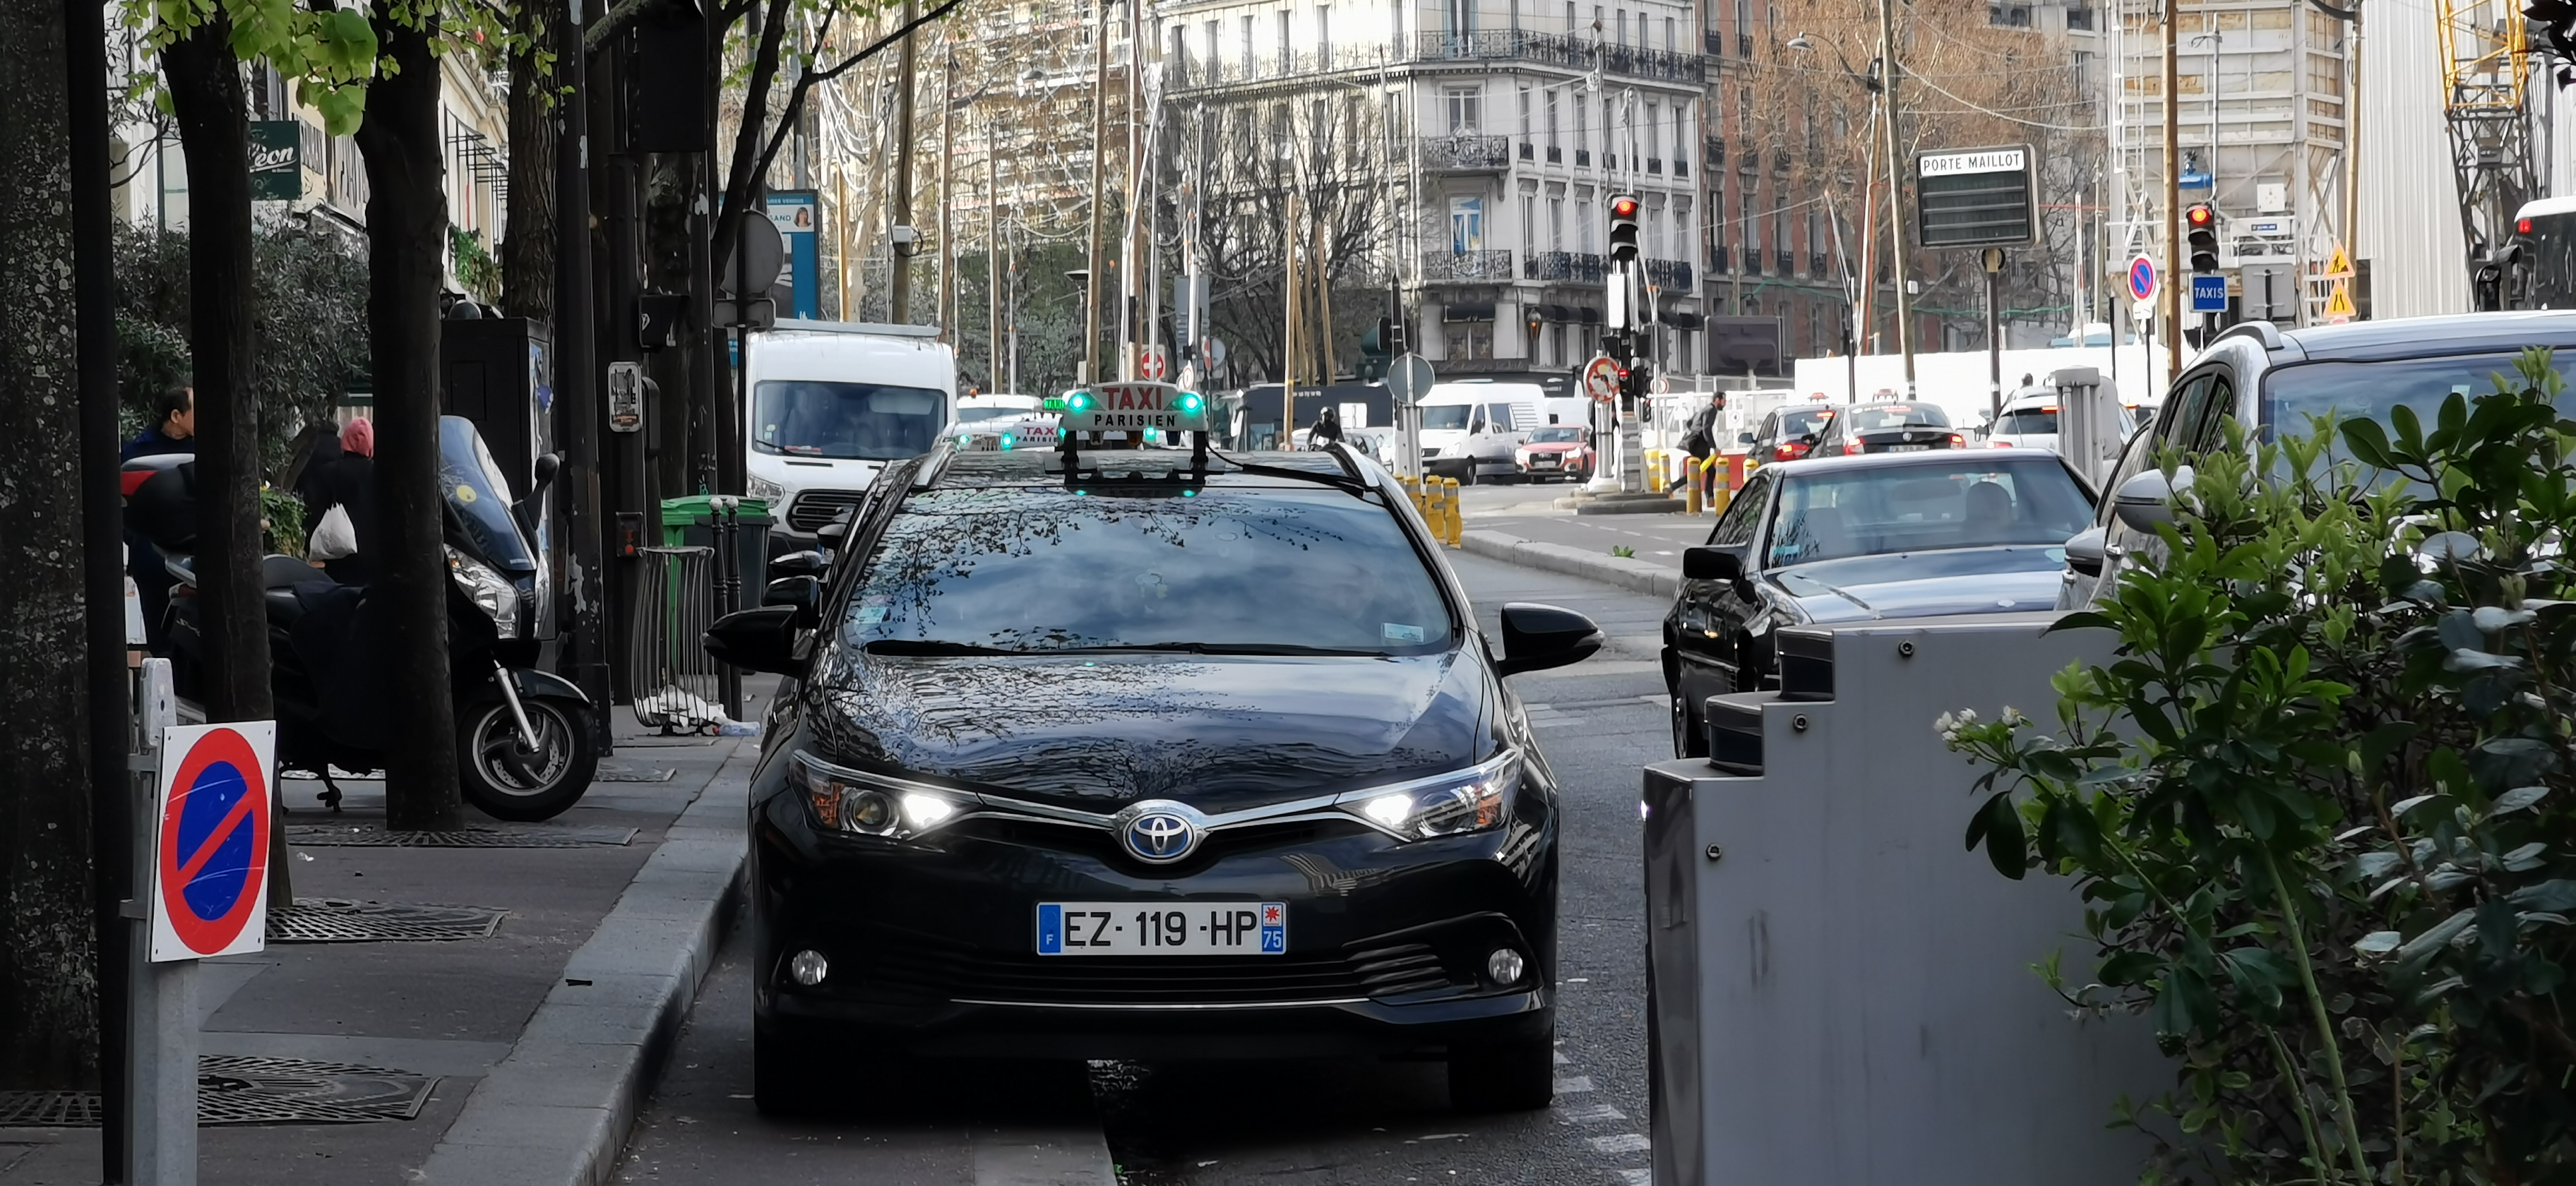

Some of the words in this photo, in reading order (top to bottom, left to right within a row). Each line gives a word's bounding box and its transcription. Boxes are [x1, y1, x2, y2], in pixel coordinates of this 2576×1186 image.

[1924, 157, 1962, 172] PORTE
[1969, 153, 2020, 169] MAILLOT
[2194, 287, 2224, 299] TAXIS
[1102, 387, 1162, 410] TAXI
[1095, 414, 1176, 427] PARISIEN
[1046, 933, 1054, 945] F
[1263, 930, 1282, 948] 75
